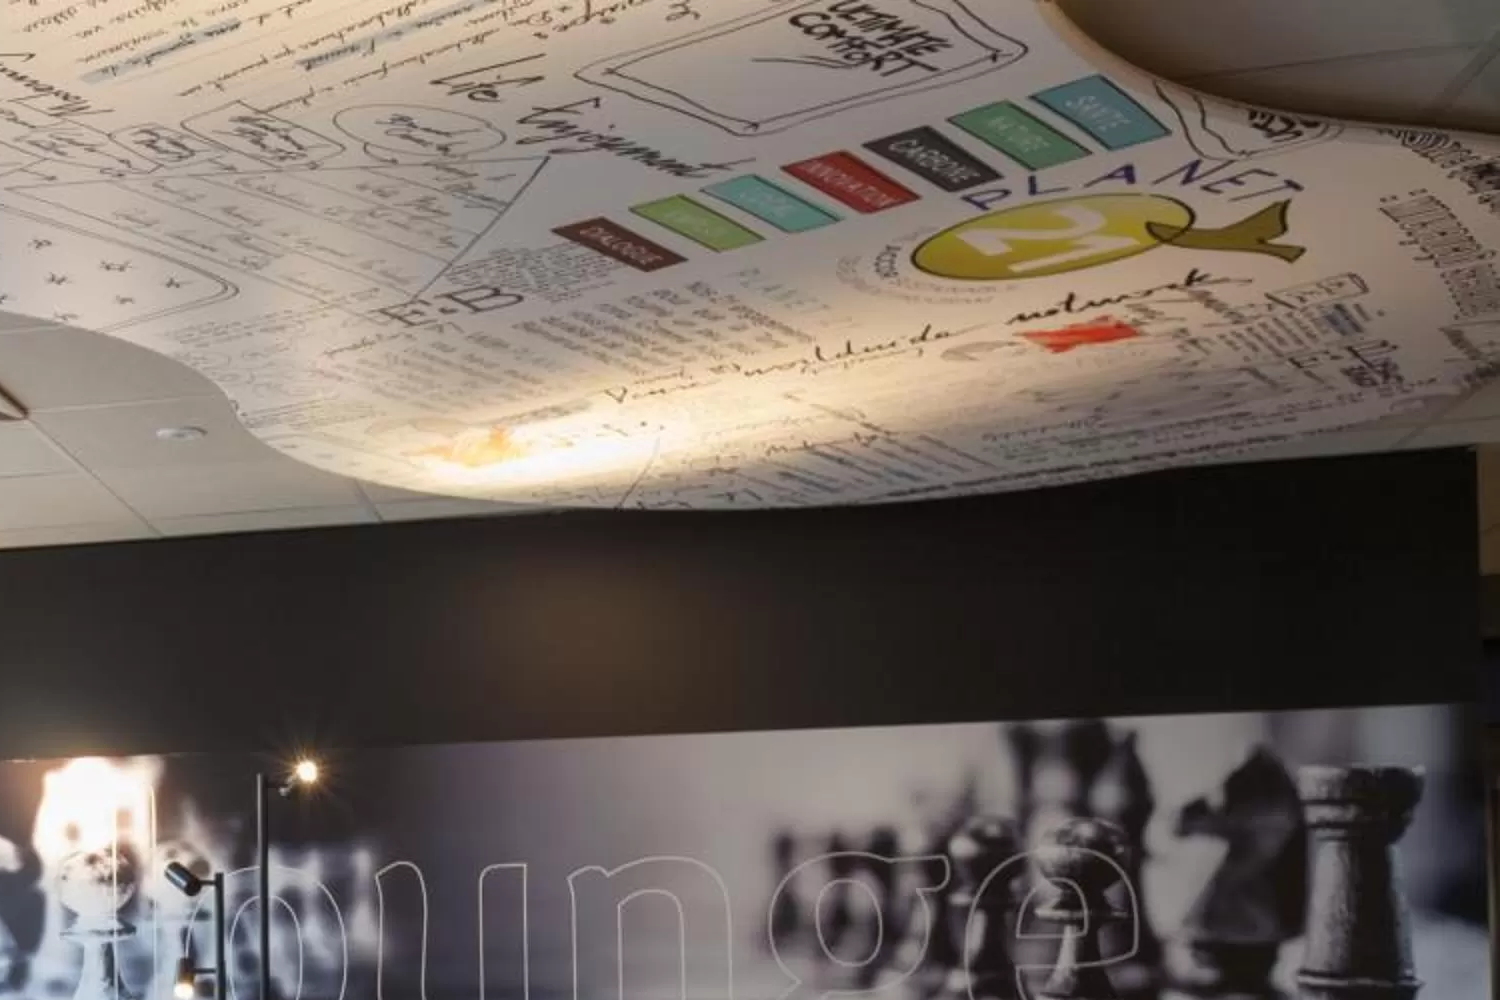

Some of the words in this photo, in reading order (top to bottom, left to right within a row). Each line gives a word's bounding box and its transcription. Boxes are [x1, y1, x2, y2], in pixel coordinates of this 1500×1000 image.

[789, 11, 940, 77] COMFORT
[827, 0, 955, 58] ULTIMATE
[960, 158, 1305, 211] PLANET
[955, 205, 1143, 273] 21
